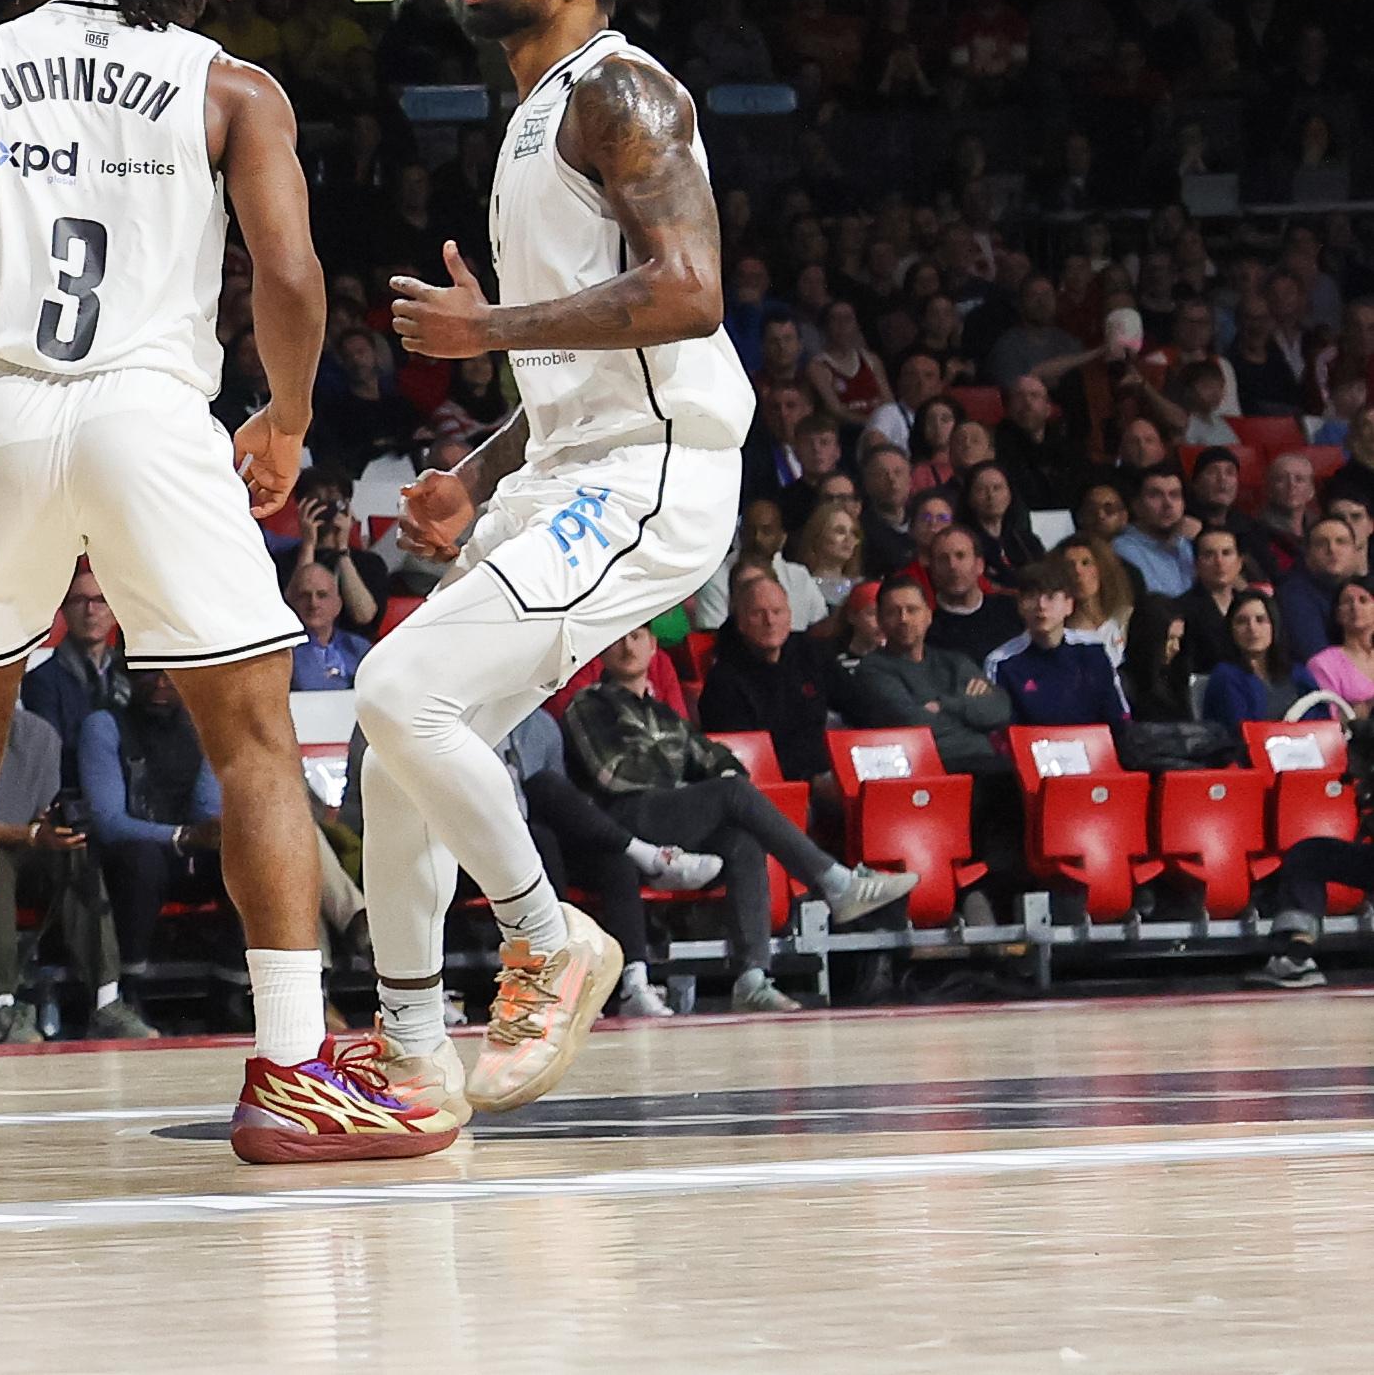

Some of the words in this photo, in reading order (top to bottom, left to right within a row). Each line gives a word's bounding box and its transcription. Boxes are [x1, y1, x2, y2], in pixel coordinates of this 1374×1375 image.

[0, 56, 181, 123] JOHNSON
[100, 158, 176, 177] logistics
[36, 216, 108, 362] 3
[512, 351, 578, 368] omobile
